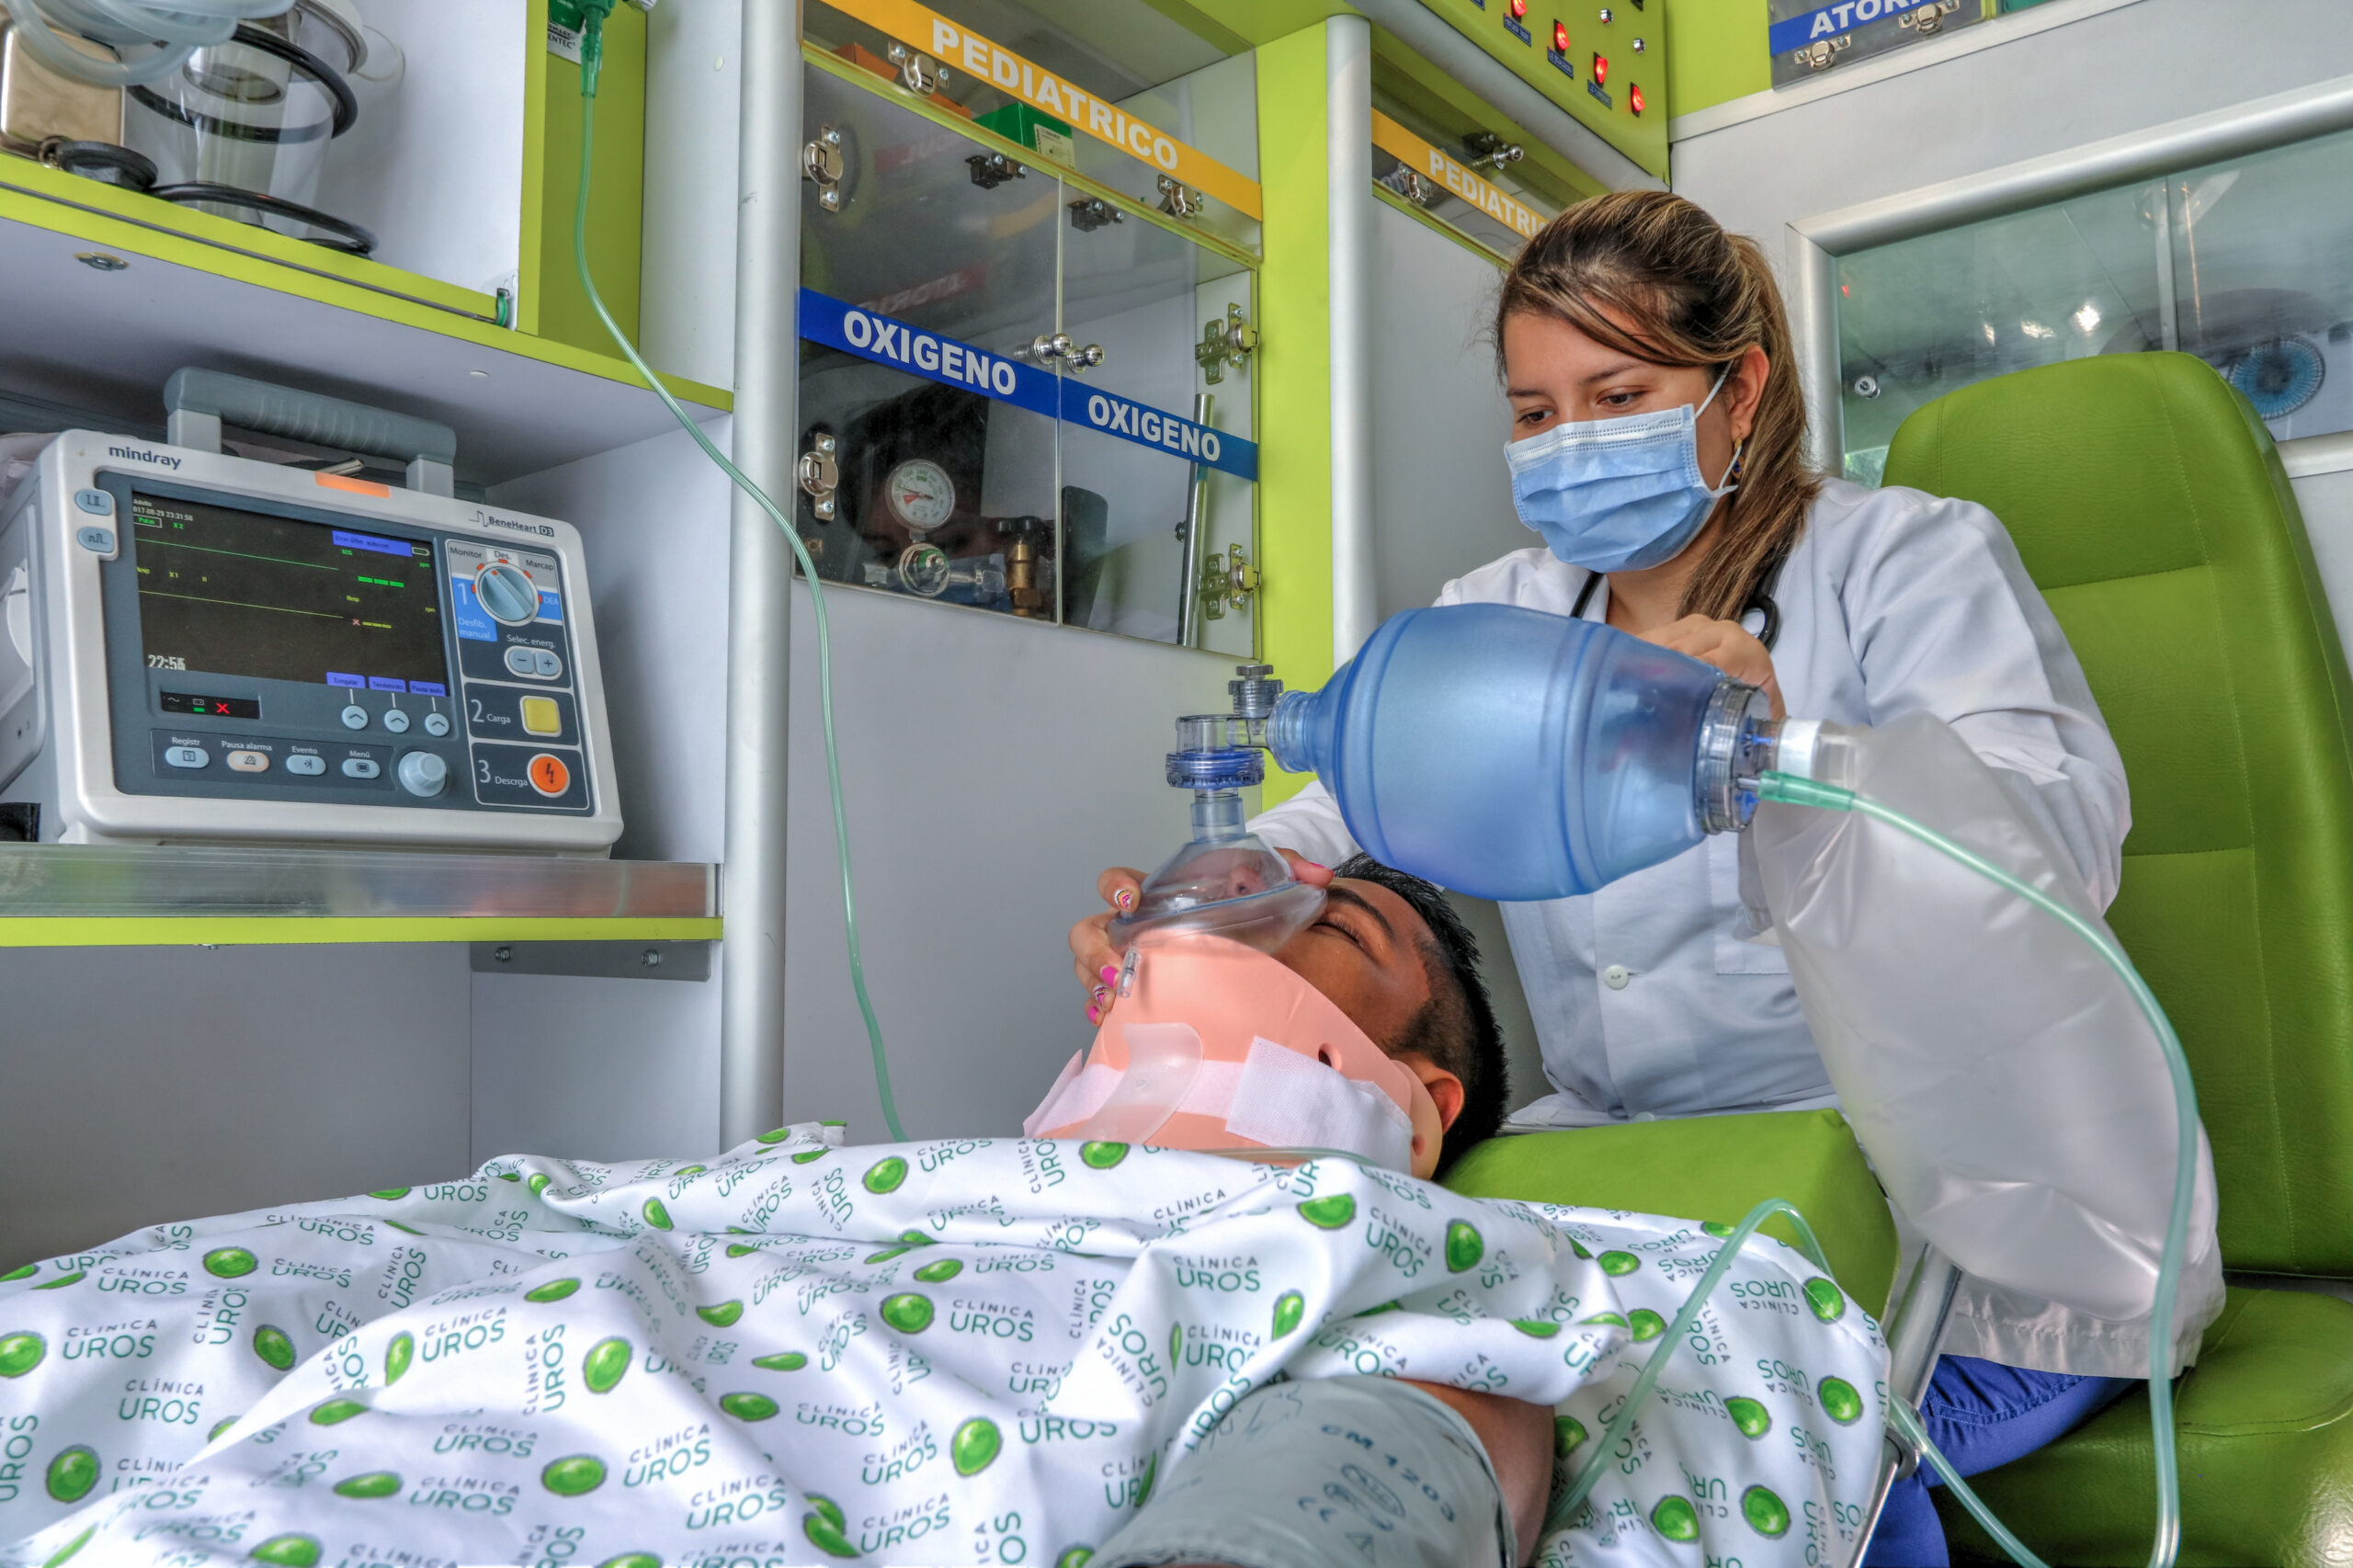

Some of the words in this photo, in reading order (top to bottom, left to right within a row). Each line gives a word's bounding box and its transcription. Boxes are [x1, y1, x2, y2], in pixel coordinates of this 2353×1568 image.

[932, 18, 1177, 170] PEDIATRICO
[843, 310, 1017, 396] OXIGENO
[1088, 394, 1221, 461] OXIGENO
[108, 446, 182, 471] mindray
[488, 517, 537, 533] BeneHeart
[540, 525, 554, 537] D3
[449, 547, 482, 558] Monitor
[494, 551, 511, 560] Des.
[526, 559, 554, 571] Marcap
[460, 629, 490, 640] manual
[471, 699, 484, 722] 2
[486, 713, 511, 724] Carga
[172, 736, 200, 746] Registr
[222, 740, 244, 749] Pausa
[245, 743, 272, 751] alarma
[291, 745, 318, 755] Evento
[478, 759, 491, 783] 3
[494, 776, 529, 788] Descrga
[1035, 1140, 1065, 1187] URO
[424, 1185, 488, 1202] UROS
[1292, 1162, 1319, 1198] UR
[824, 1167, 853, 1222] UROS
[300, 1221, 373, 1244] UROS
[1056, 1217, 1101, 1252] ROS
[1366, 1221, 1424, 1278] UROS
[272, 1267, 351, 1288] UROS
[391, 1248, 426, 1308] UROS
[976, 1259, 1054, 1273] UROS
[98, 1278, 187, 1294] UROS
[1177, 1268, 1260, 1292] UROS
[1730, 1281, 1796, 1299] UROS
[1089, 1279, 1115, 1329] ROS
[316, 1313, 349, 1338] UR
[949, 1312, 1034, 1342] UROS
[63, 1335, 155, 1359] UROS
[422, 1319, 506, 1362] UROS
[822, 1320, 868, 1370] UROS
[1687, 1321, 1716, 1367] ROS
[542, 1324, 565, 1413] UROS
[1109, 1314, 1167, 1401] UROS
[1186, 1344, 1254, 1373] URO
[1009, 1376, 1061, 1401] URO
[119, 1398, 200, 1425] UROS
[796, 1412, 884, 1437] UROS
[0, 1415, 39, 1502] UROS
[434, 1434, 536, 1458] UROS
[862, 1434, 938, 1485] UROS
[623, 1438, 710, 1487] UROS
[410, 1490, 517, 1516] UROS
[687, 1488, 785, 1529] UROS
[860, 1506, 950, 1554] UROS
